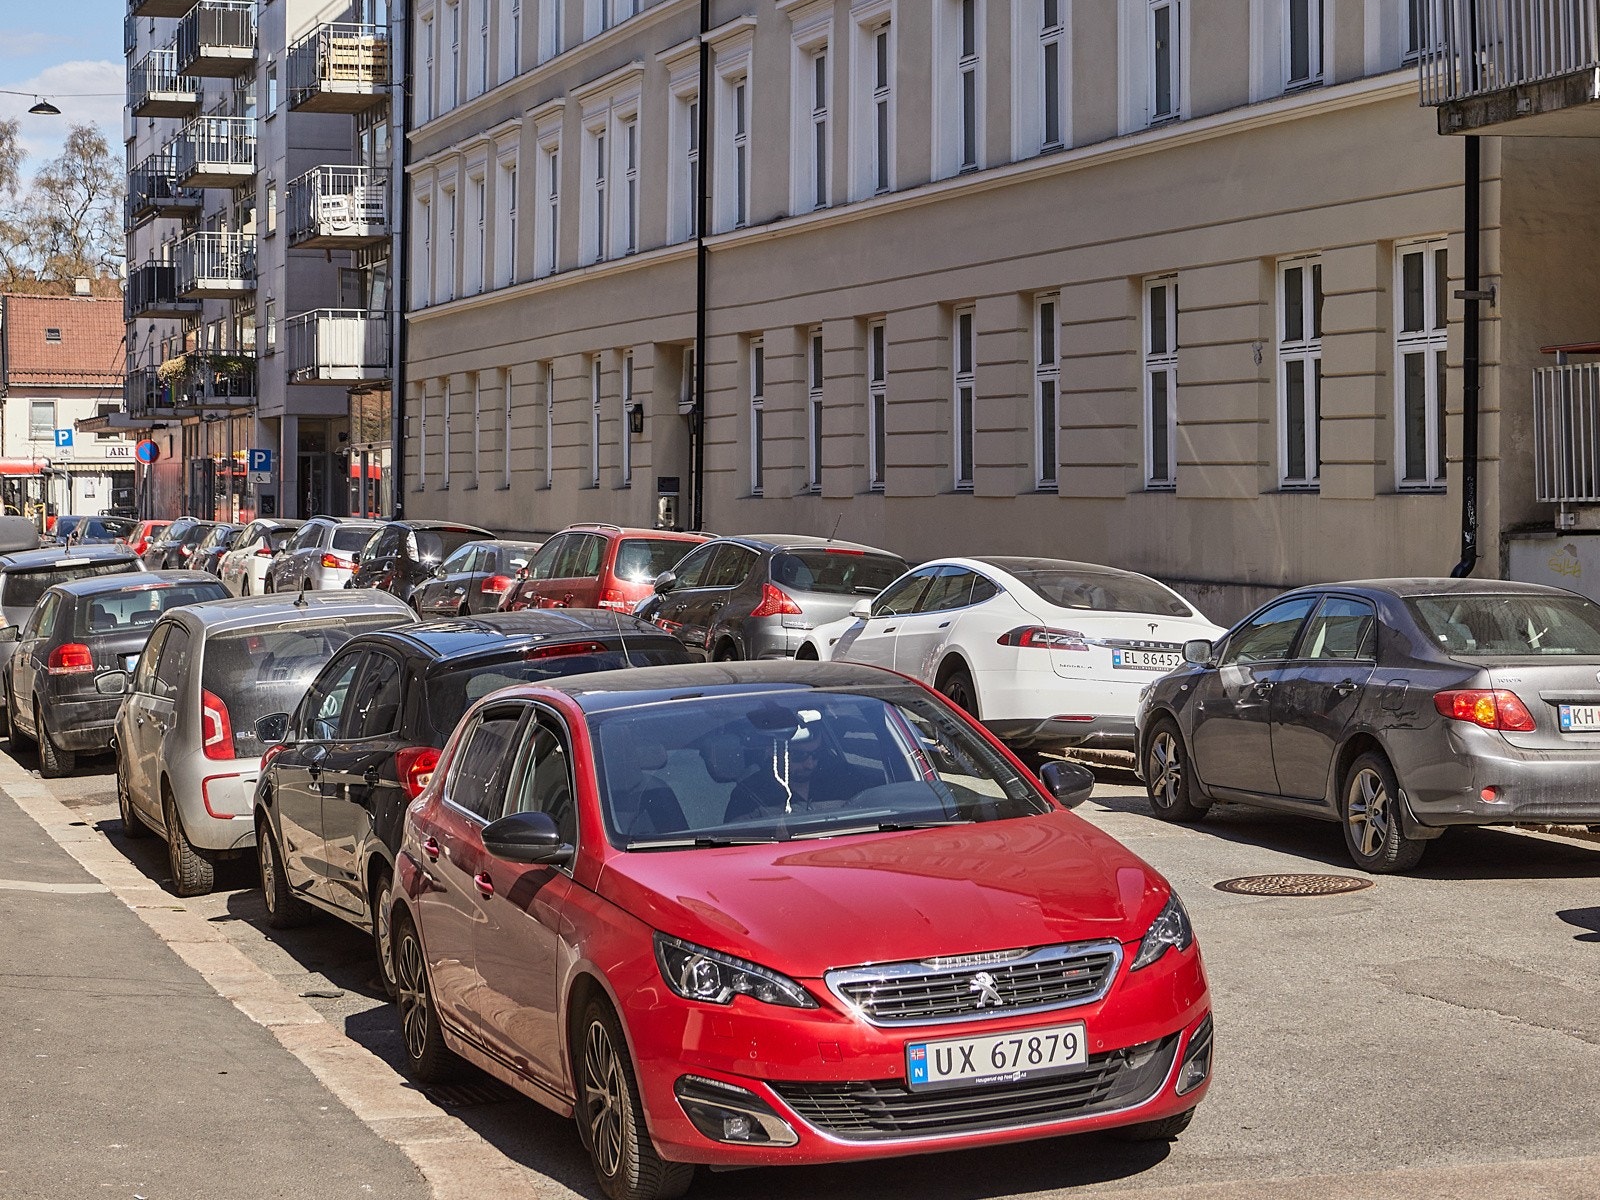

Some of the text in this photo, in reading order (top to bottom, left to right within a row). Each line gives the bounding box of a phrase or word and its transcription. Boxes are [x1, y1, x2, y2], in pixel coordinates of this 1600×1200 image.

[58, 431, 69, 445] P
[109, 446, 129, 456] ARI
[254, 451, 266, 469] P
[1124, 652, 1180, 666] EL 86452
[1573, 708, 1594, 724] KH
[935, 1032, 1078, 1075] UX 67879
[914, 1067, 923, 1077] N
